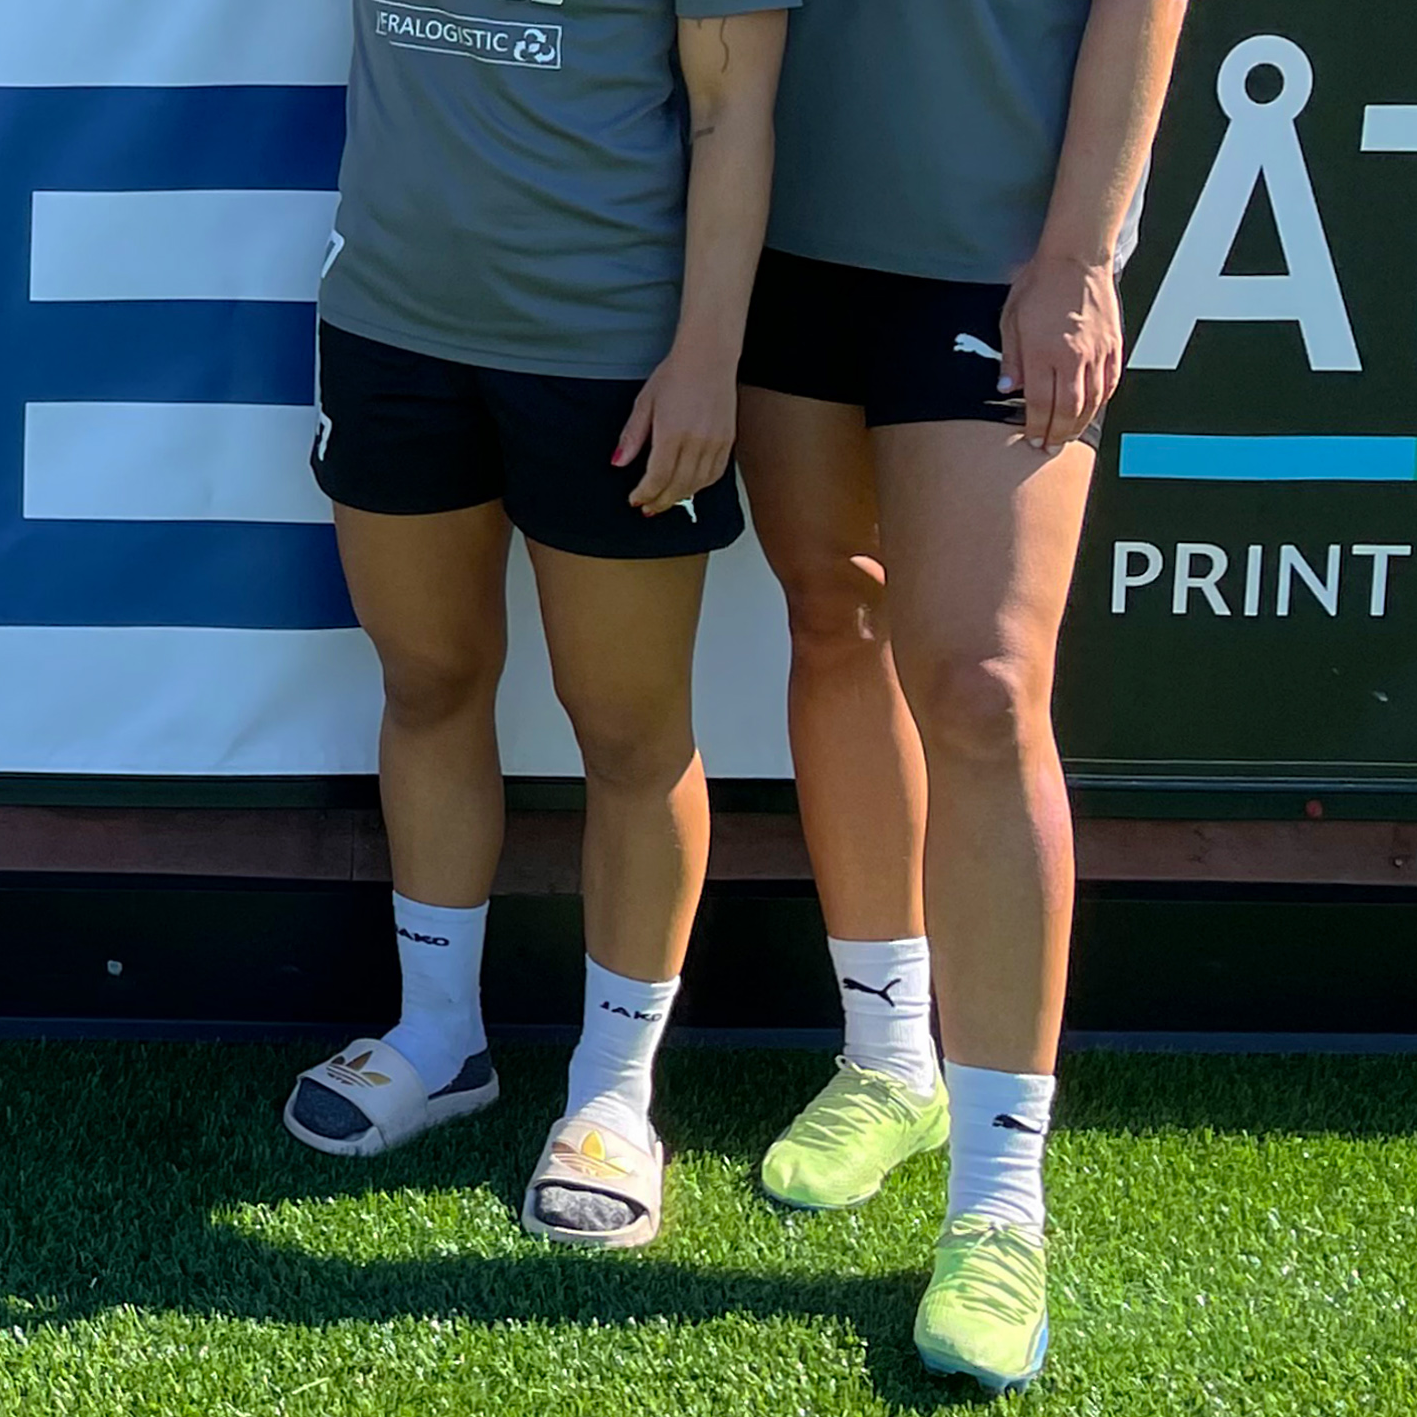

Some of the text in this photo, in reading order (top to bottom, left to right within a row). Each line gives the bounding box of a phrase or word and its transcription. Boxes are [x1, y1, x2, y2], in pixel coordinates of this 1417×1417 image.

[379, 10, 509, 52] FRALOGISTIC
[1126, 34, 1417, 373] Å
[1110, 540, 1413, 618] PRINT
[396, 925, 450, 947] AKO
